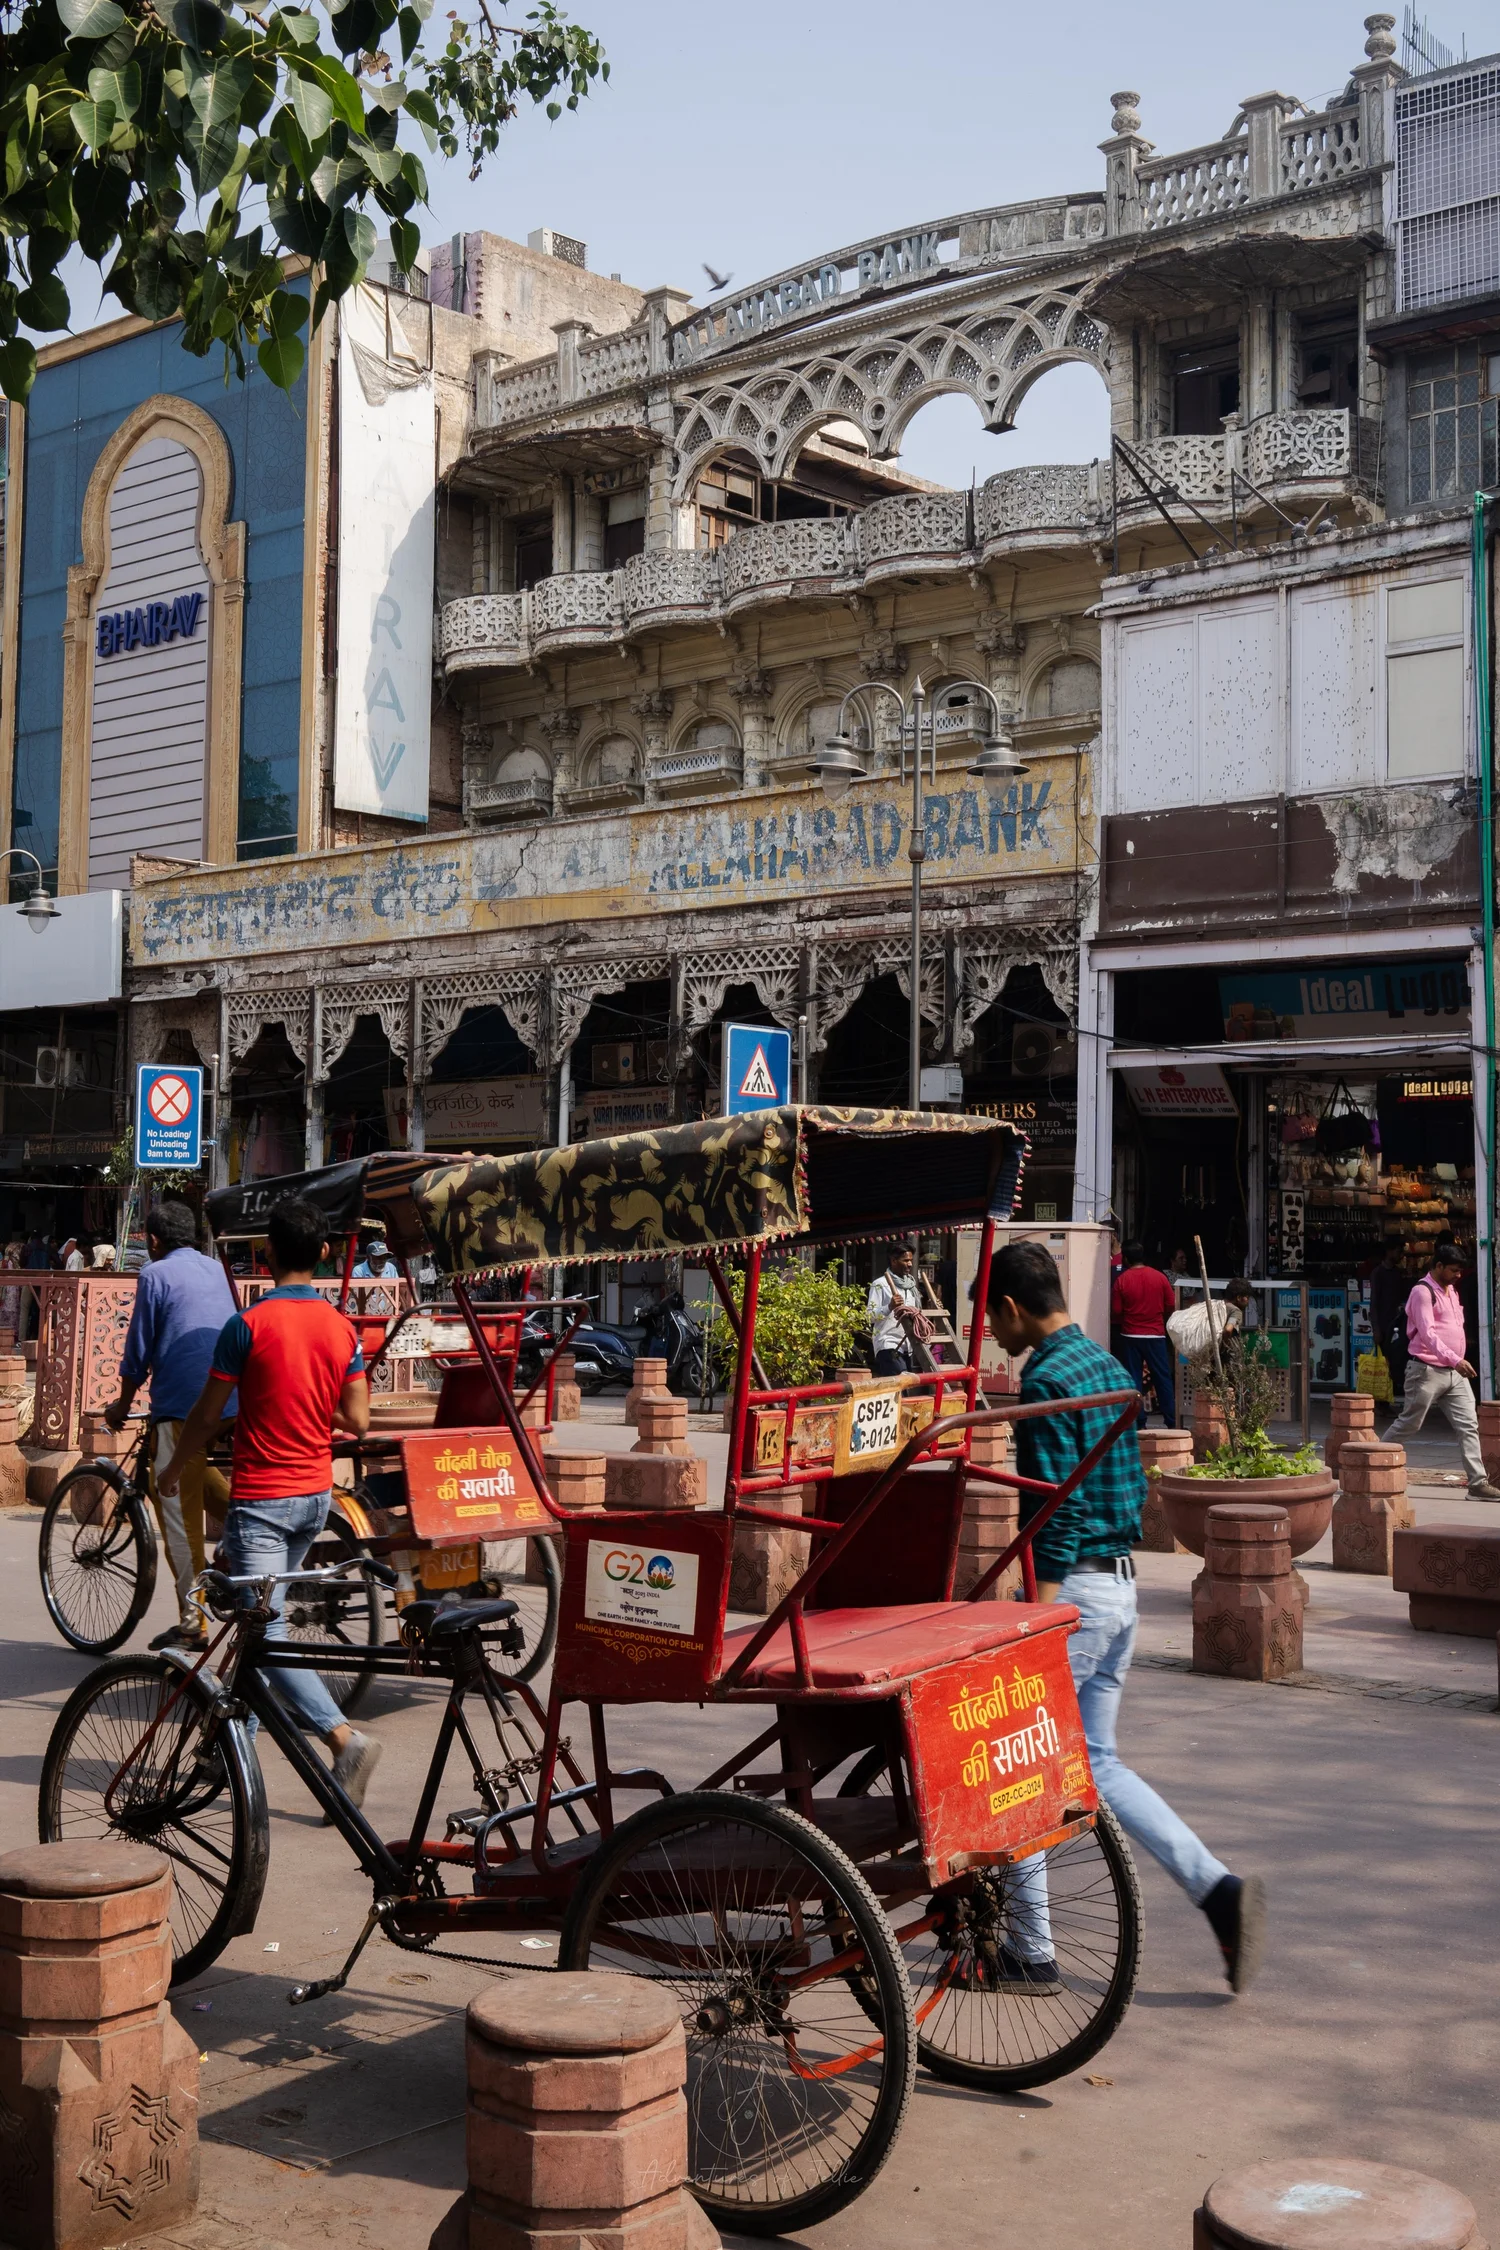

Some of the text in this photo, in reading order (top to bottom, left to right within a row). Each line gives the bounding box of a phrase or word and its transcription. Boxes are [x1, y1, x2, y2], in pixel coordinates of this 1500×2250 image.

[672, 264, 842, 366] ALLAHABAD
[857, 232, 941, 288] BANK
[98, 592, 202, 657] BHAIRAV
[923, 781, 1053, 862] BANK
[1300, 974, 1375, 1015] Ideal
[427, 1090, 515, 1112] पतंजलि केन्द्र
[1134, 1087, 1229, 1104] L N ENTERPRISE
[1404, 1081, 1433, 1097] Ideal
[614, 1104, 645, 1123] PRAKASH
[964, 1102, 1037, 1120] THERS
[147, 1129, 192, 1140] No Loading/
[466, 1120, 499, 1130] Enterprise
[1016, 1120, 1061, 1128] KNITTED
[147, 1149, 190, 1160] 9am to 9pm
[150, 1139, 187, 1150] Unloading
[1037, 1204, 1055, 1219] SALE
[1279, 1292, 1301, 1306] Ideal
[857, 1398, 894, 1423] CSPZ-
[851, 1424, 897, 1452] C-0124
[433, 1444, 512, 1474] चाँदनी चौक
[436, 1468, 516, 1501] की सवारी!
[604, 1550, 675, 1590] G20
[634, 1617, 651, 1625] FAMILY
[663, 1622, 681, 1630] FUTURE
[575, 1622, 704, 1651] MUNICIPAL CORPORATION OF DELHI
[948, 1665, 1046, 1732] चाँदनी चौक
[960, 1705, 1061, 1787] की सवारी!
[992, 1778, 1042, 1809] CSPZ-CC-0124
[1061, 1770, 1091, 1795] Chowk
